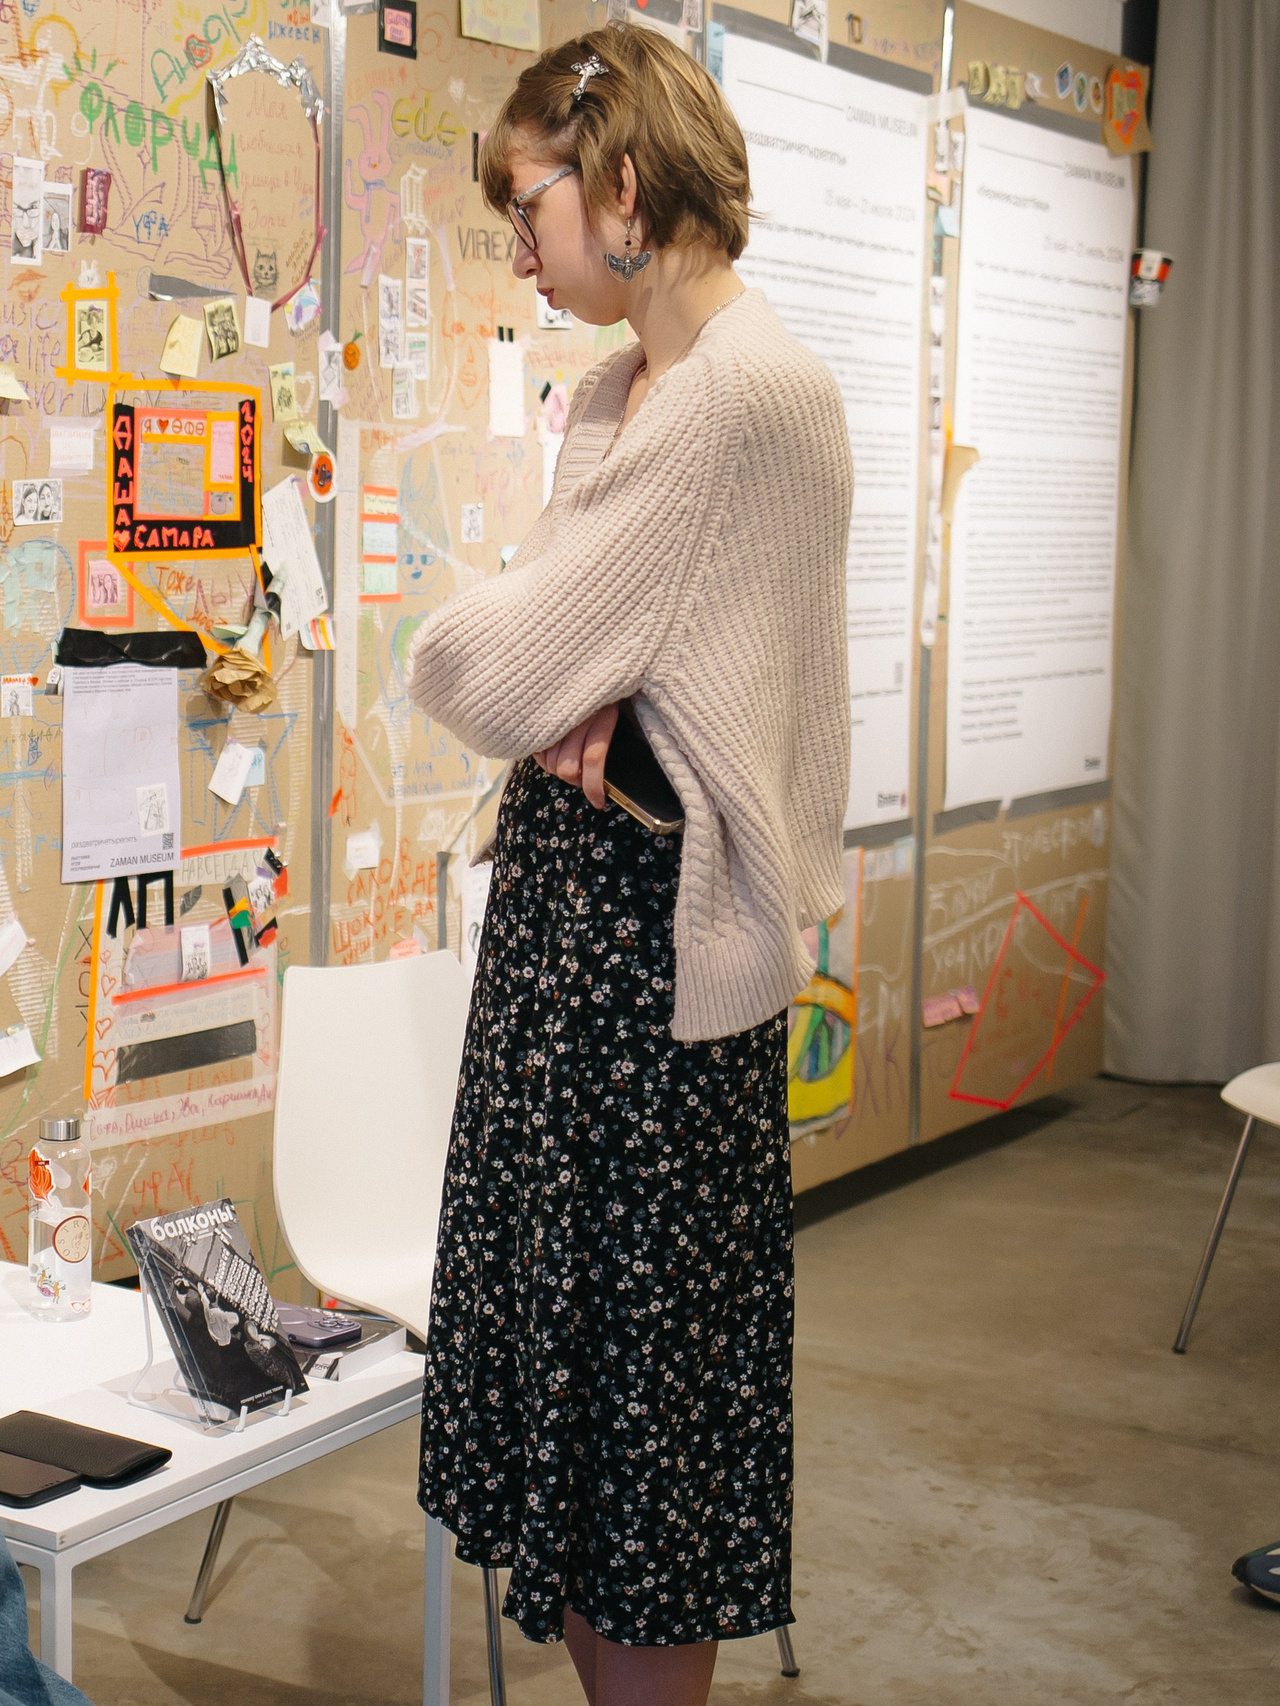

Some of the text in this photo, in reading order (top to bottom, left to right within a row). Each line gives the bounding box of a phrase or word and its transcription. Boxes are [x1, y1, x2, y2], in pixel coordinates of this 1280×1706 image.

[79, 82, 238, 192] ФЛОРИДА
[143, 418, 153, 434] Я
[241, 401, 253, 483] 2024
[113, 415, 134, 526] ДАША
[133, 525, 216, 549] САМАРА
[109, 852, 175, 868] ZAMAN MUSEUM
[150, 1205, 234, 1241] балконы
